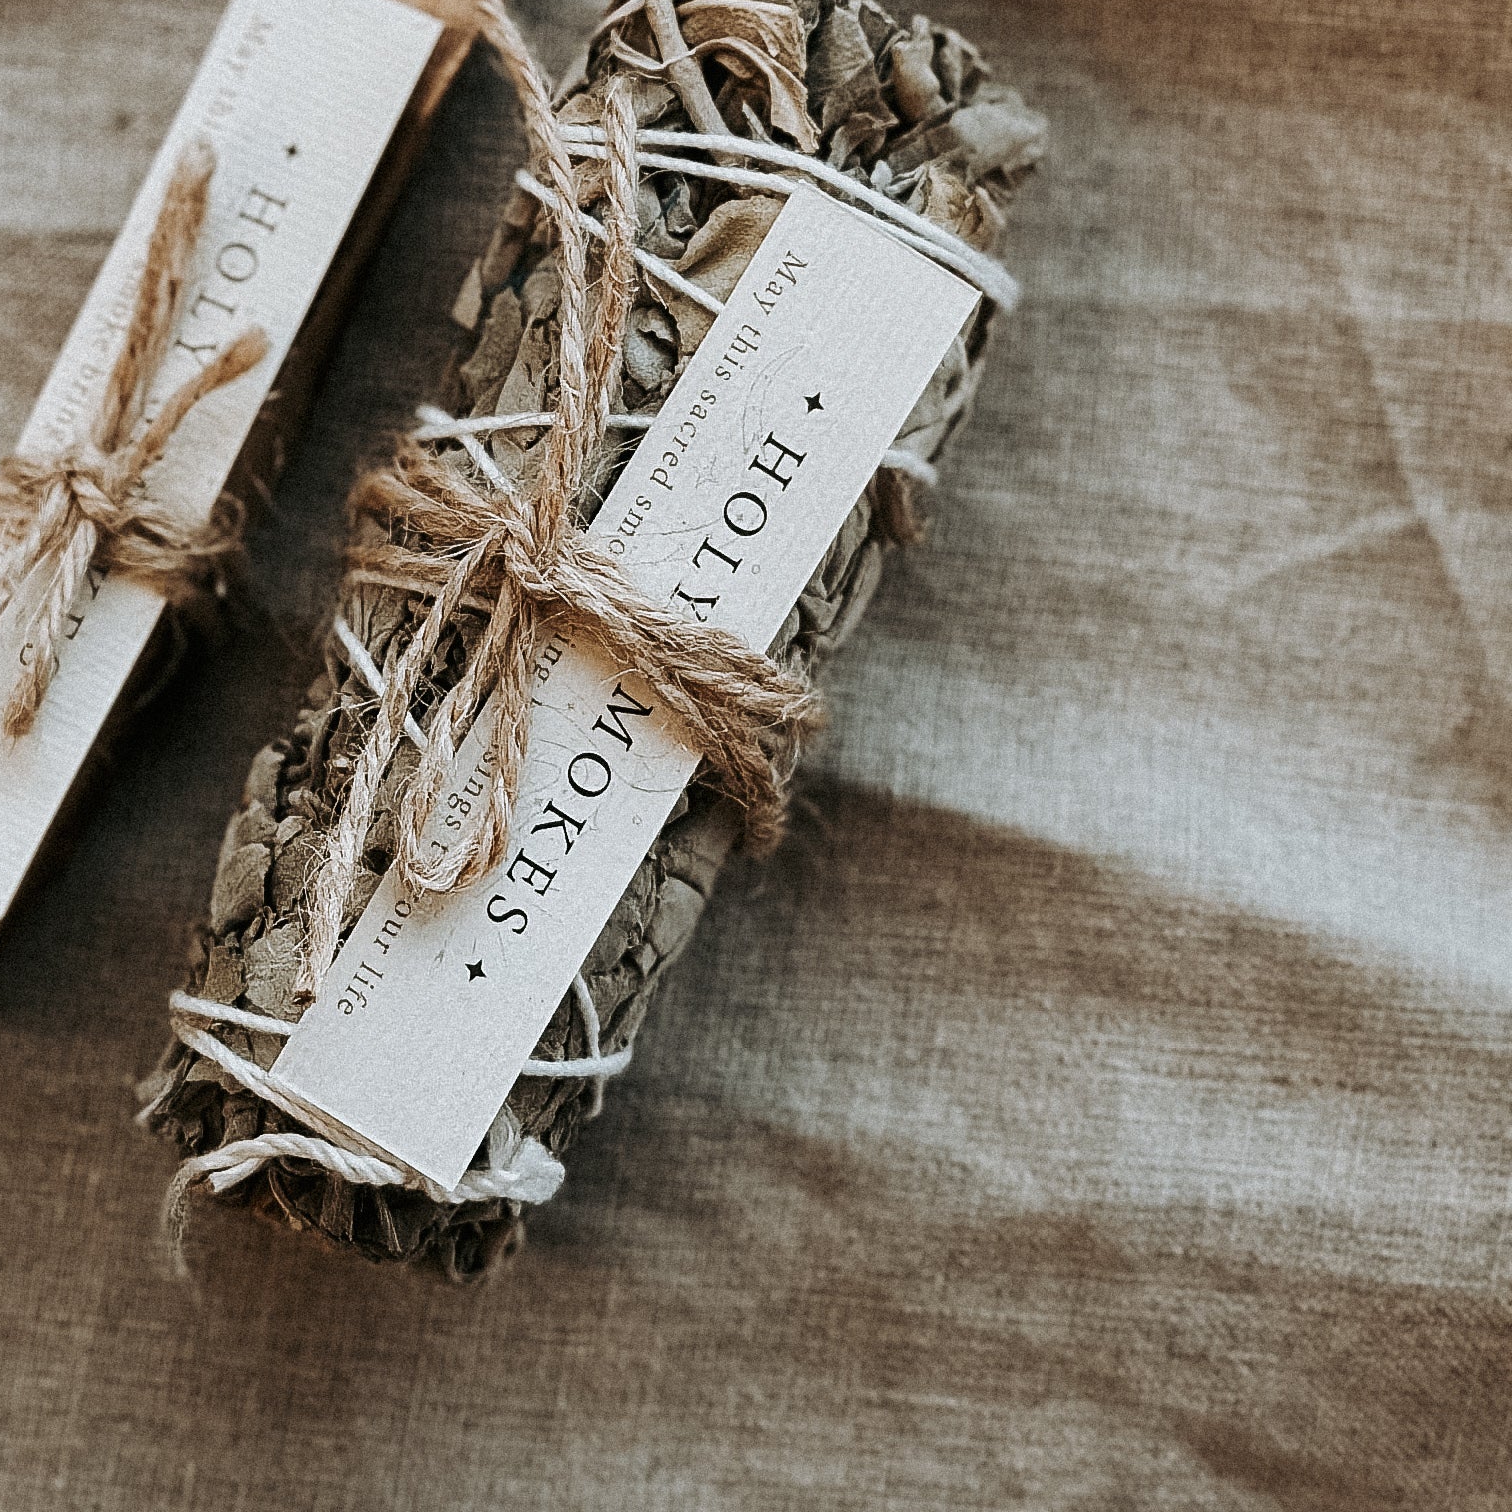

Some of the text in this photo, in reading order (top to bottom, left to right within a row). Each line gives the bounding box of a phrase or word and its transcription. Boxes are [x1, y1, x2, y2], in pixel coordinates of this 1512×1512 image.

[173, 186, 288, 365] HOLY
[751, 249, 807, 316] May
[714, 323, 761, 381] this
[649, 388, 717, 489] sacred
[608, 494, 652, 555] smo
[484, 430, 806, 935] HOLY MOKES
[372, 885, 421, 954] our
[336, 961, 383, 1016] life
